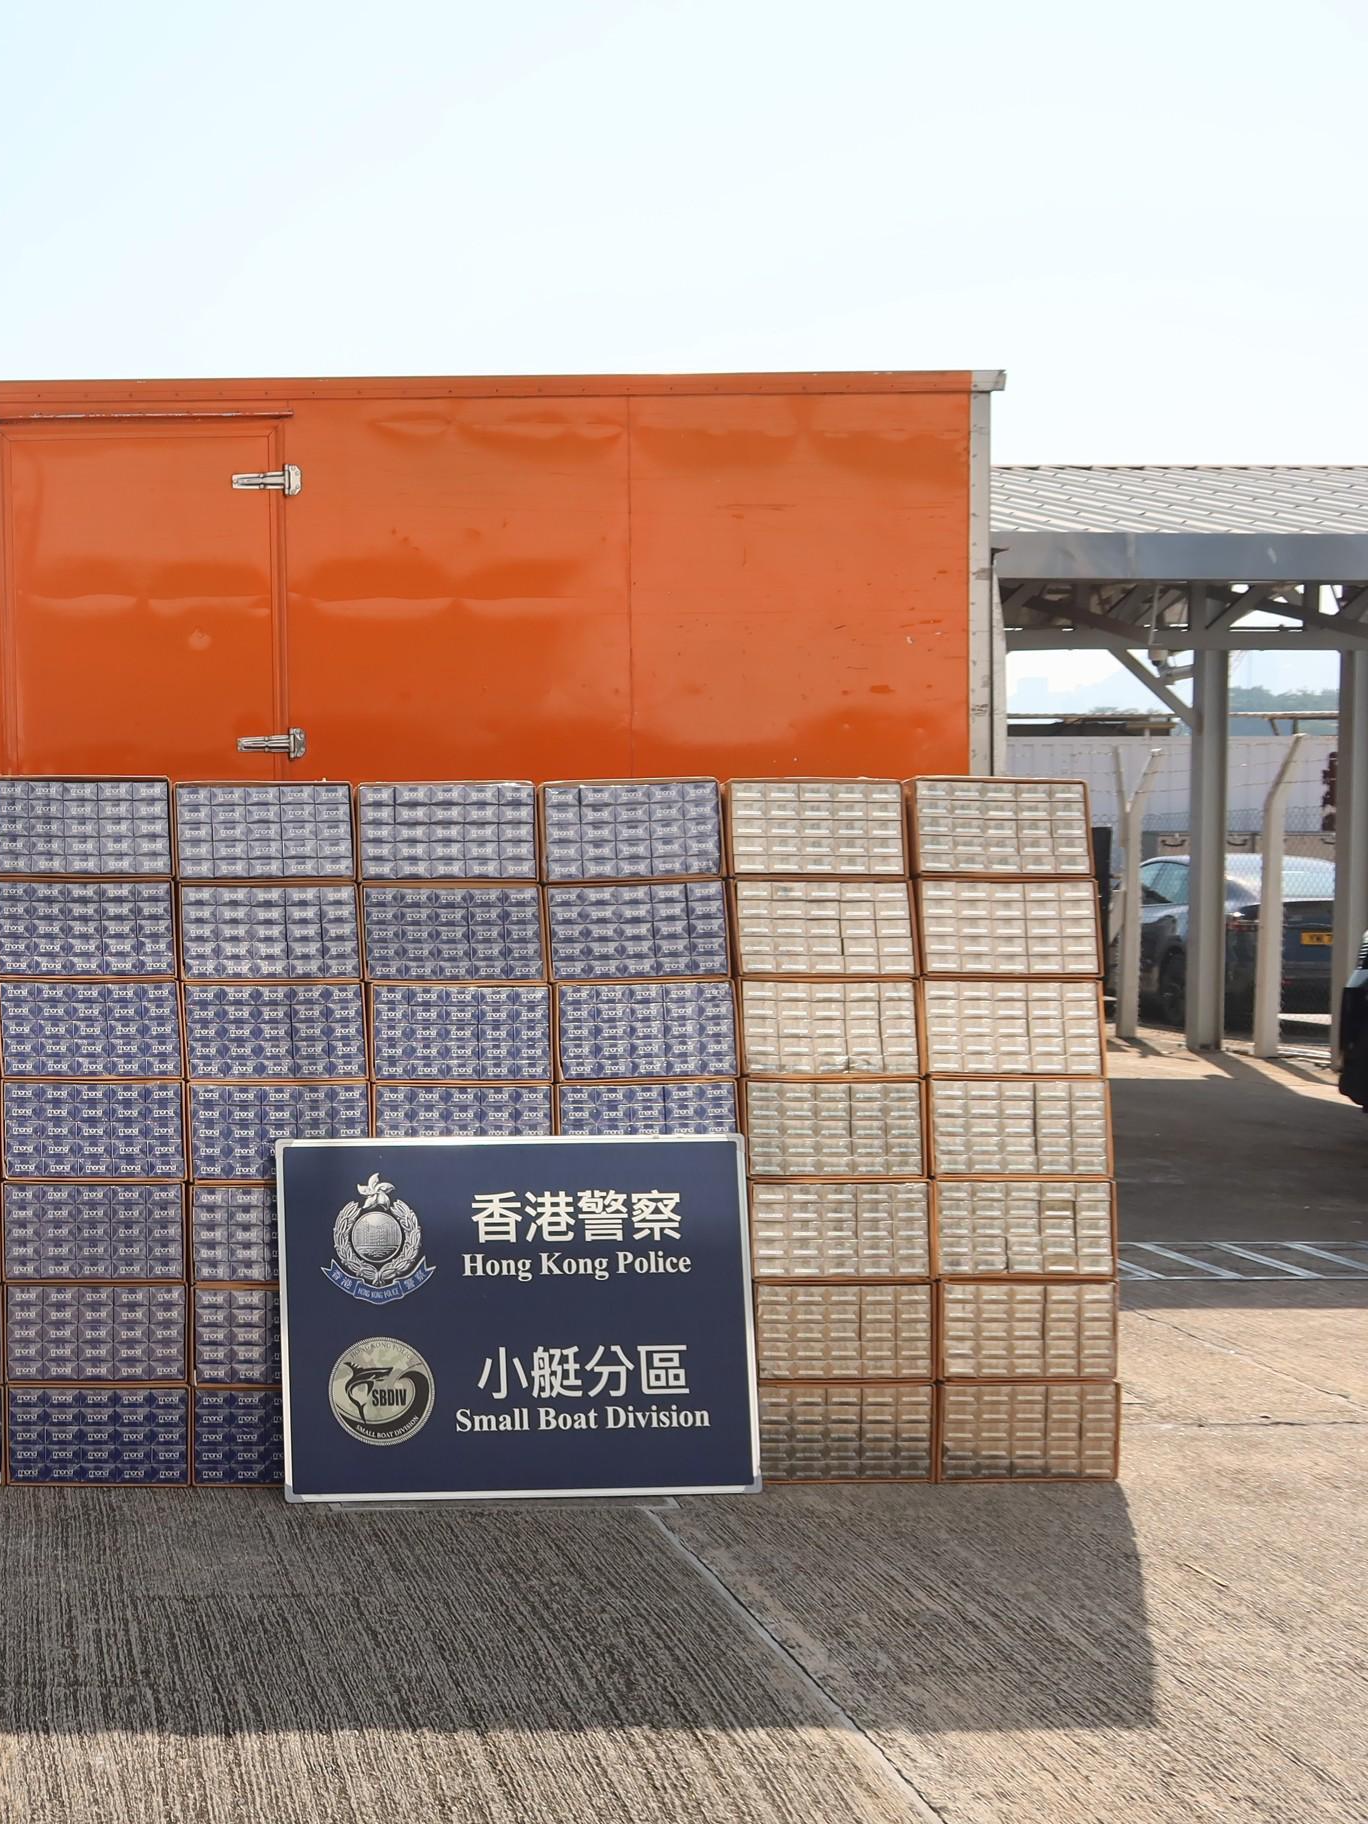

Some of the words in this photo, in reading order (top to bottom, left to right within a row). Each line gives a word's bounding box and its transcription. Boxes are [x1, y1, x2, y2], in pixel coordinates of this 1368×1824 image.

[515, 966, 536, 974] mond
[8, 1006, 29, 1014] mond
[43, 1007, 64, 1015] mond
[114, 1007, 135, 1015] mond
[194, 1028, 215, 1036] mond
[568, 1028, 589, 1036] mond
[230, 1046, 251, 1054] mond
[382, 1066, 403, 1074] mond
[417, 1066, 438, 1074] mond
[383, 1092, 404, 1100] mond
[82, 1108, 103, 1116] mond
[234, 1110, 255, 1118] mond
[269, 1110, 290, 1118] mond
[568, 1110, 589, 1118] mond
[603, 1110, 624, 1118] mond
[118, 1127, 139, 1135] mond
[154, 1145, 175, 1153] mond
[83, 1209, 104, 1217] mond
[471, 1189, 682, 1243] 香港警察
[462, 1253, 532, 1282] Hong
[540, 1252, 609, 1281] Kong
[616, 1250, 692, 1274] Police
[156, 1329, 177, 1337] mond
[15, 1347, 36, 1355] mond
[156, 1347, 177, 1355] mond
[15, 1366, 36, 1374] mond
[121, 1366, 142, 1374] mond
[157, 1366, 178, 1374] mond
[477, 1344, 690, 1399] 小艇分區
[202, 1396, 223, 1404] mond
[372, 1388, 407, 1407] SBDIV
[202, 1414, 223, 1422] mond
[455, 1407, 530, 1432] Small
[537, 1407, 598, 1430] Boat
[605, 1404, 710, 1429] Division
[202, 1433, 223, 1441] mond
[17, 1450, 38, 1458] mond
[87, 1450, 108, 1458] mond
[88, 1469, 109, 1477] mond
